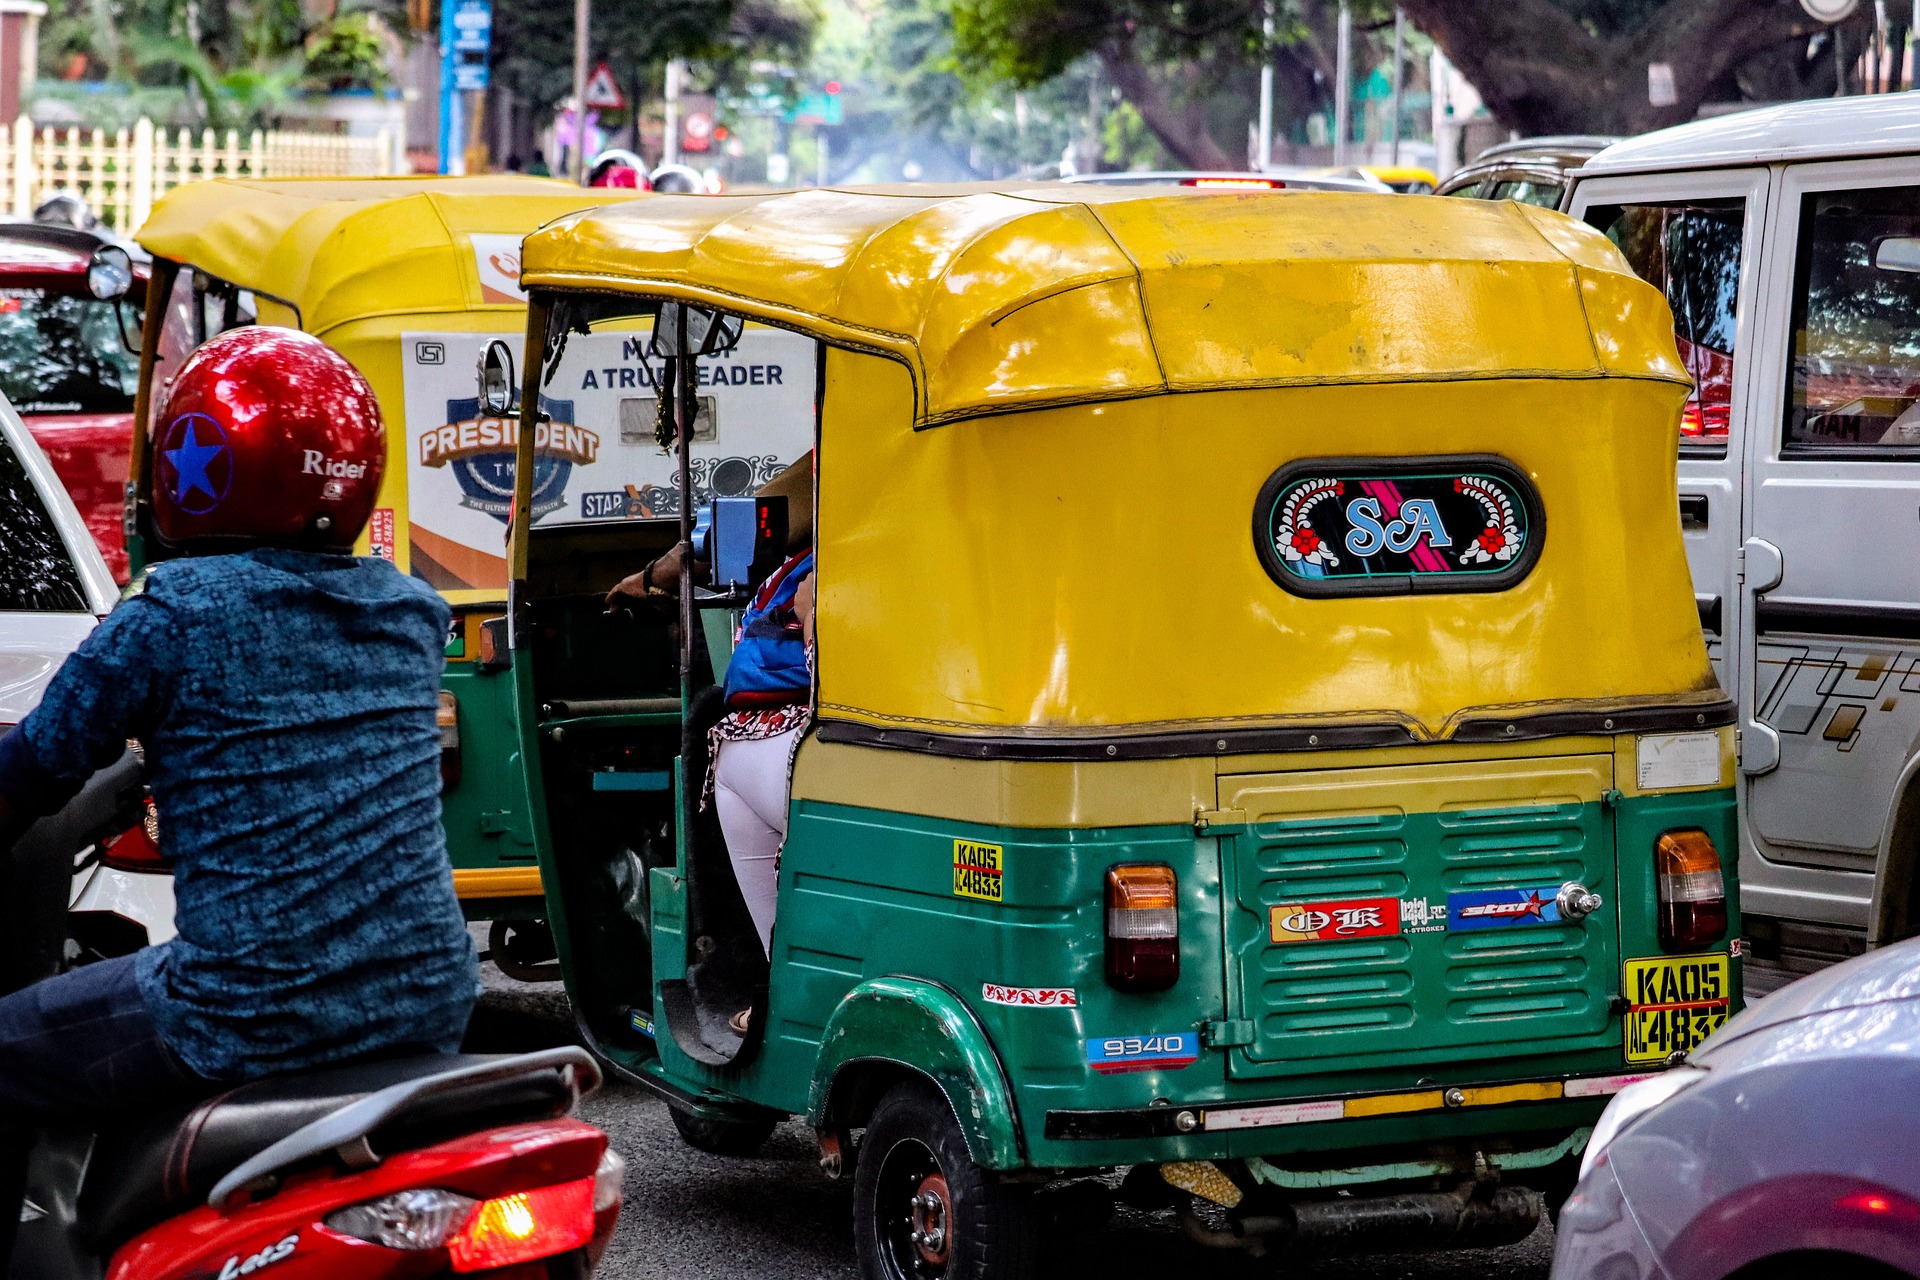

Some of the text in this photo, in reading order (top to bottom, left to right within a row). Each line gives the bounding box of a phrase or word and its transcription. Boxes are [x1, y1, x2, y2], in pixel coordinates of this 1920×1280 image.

[581, 369, 599, 390] A
[697, 365, 783, 386] EADER
[301, 448, 368, 479] Rider
[484, 502, 512, 513] ULTIMA
[1345, 497, 1453, 557] SA
[1102, 1035, 1184, 1057] 9340
